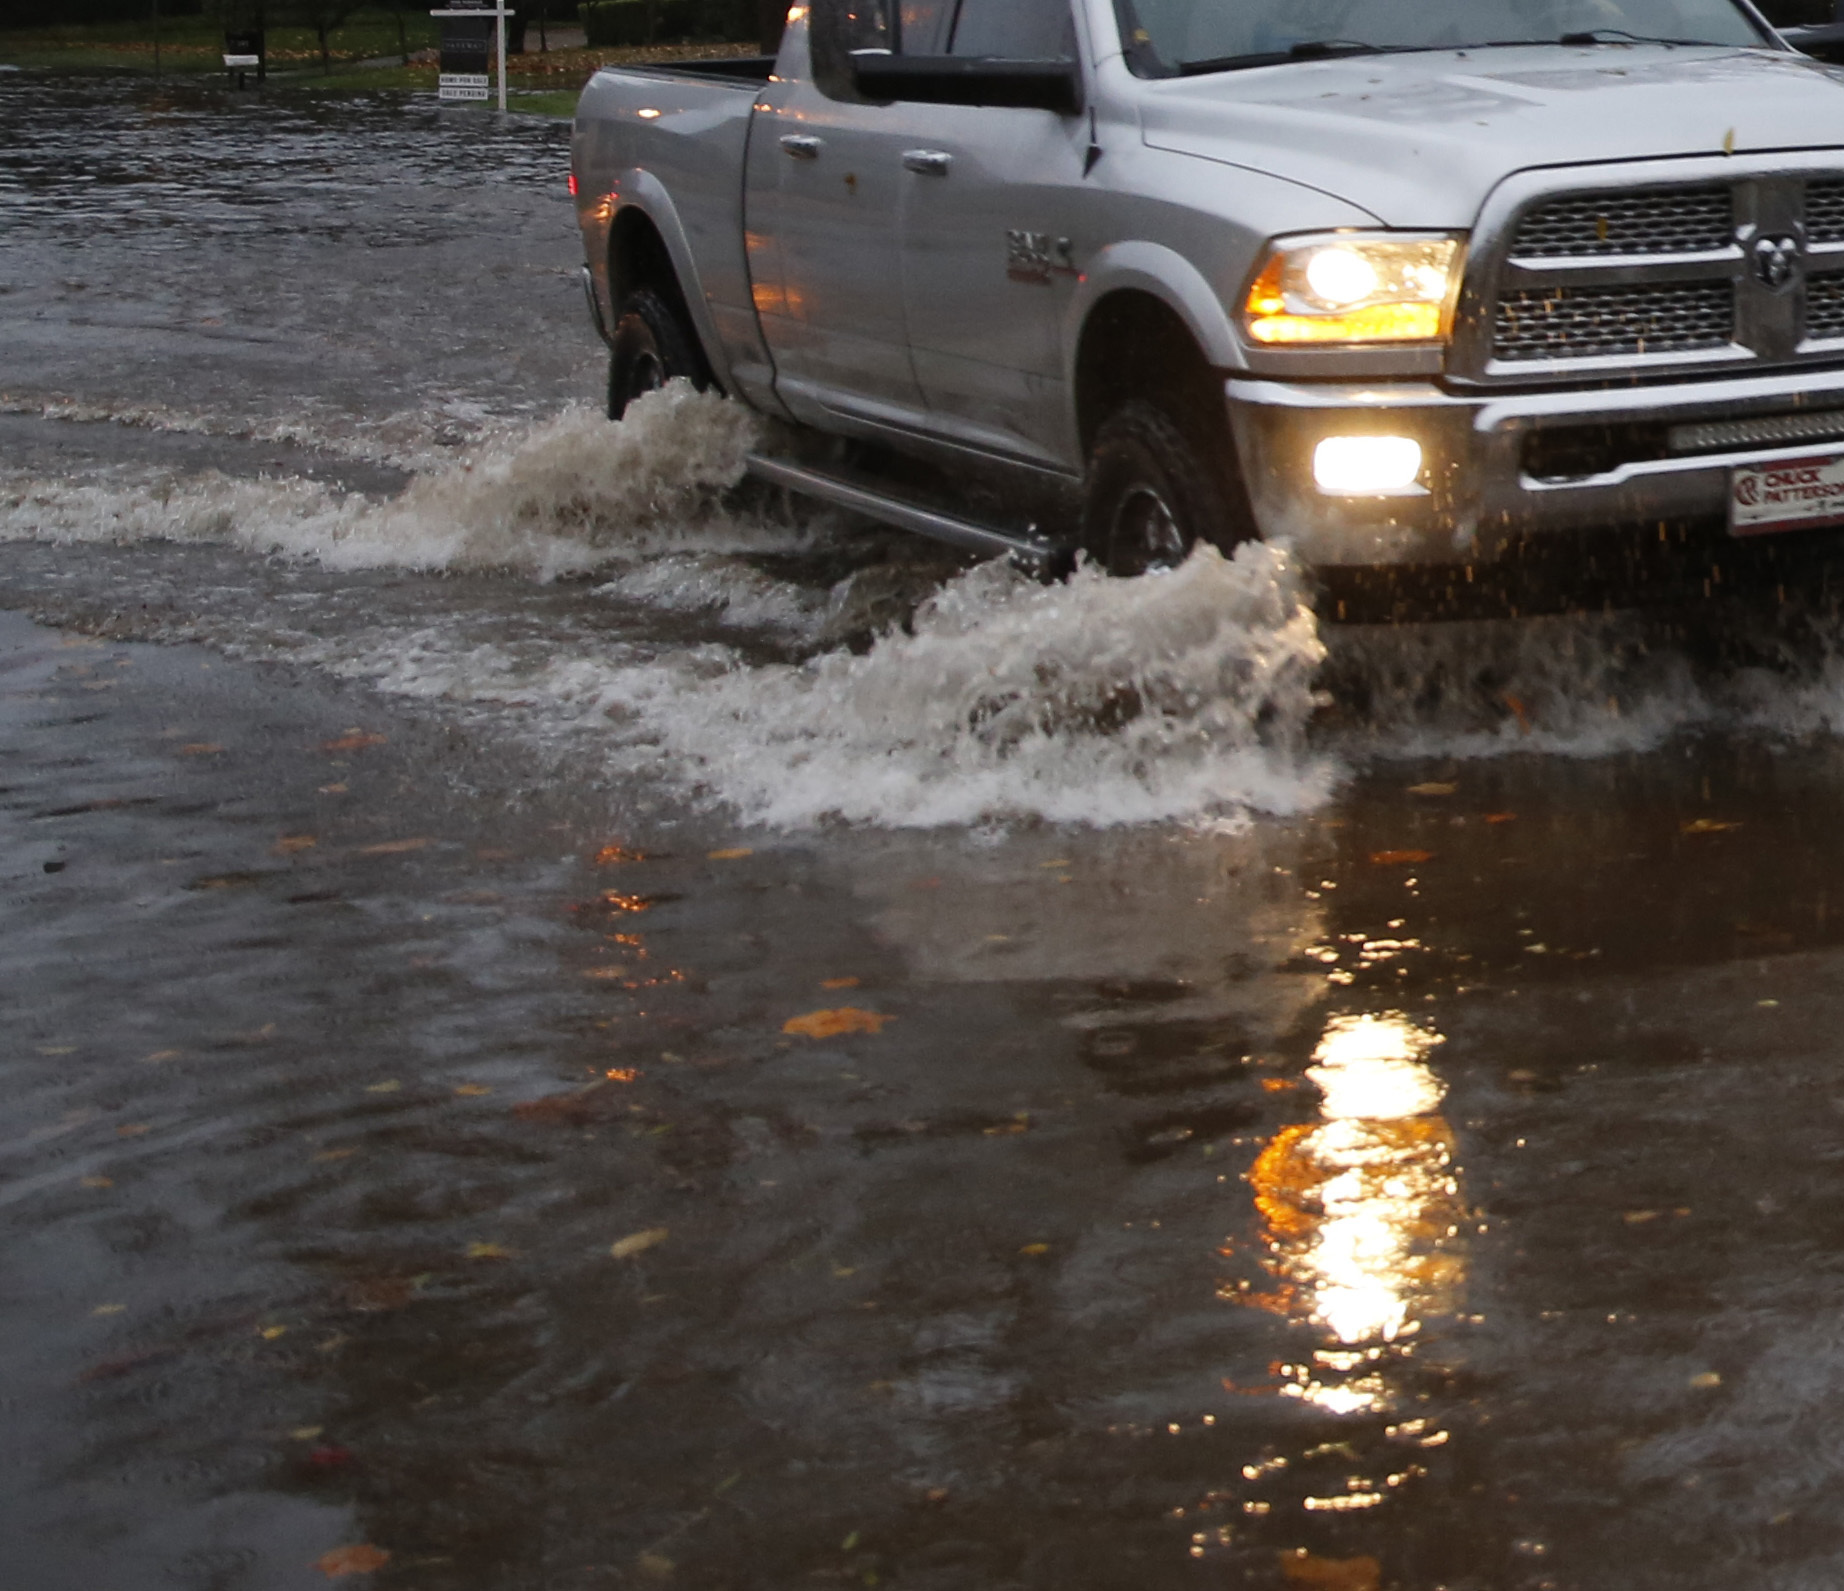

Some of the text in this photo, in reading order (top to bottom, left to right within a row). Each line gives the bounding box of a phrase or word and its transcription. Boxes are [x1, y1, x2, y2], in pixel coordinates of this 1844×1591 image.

[459, 76, 471, 84] FOR
[459, 89, 485, 97] PENDING
[1765, 468, 1822, 488] CHUCK
